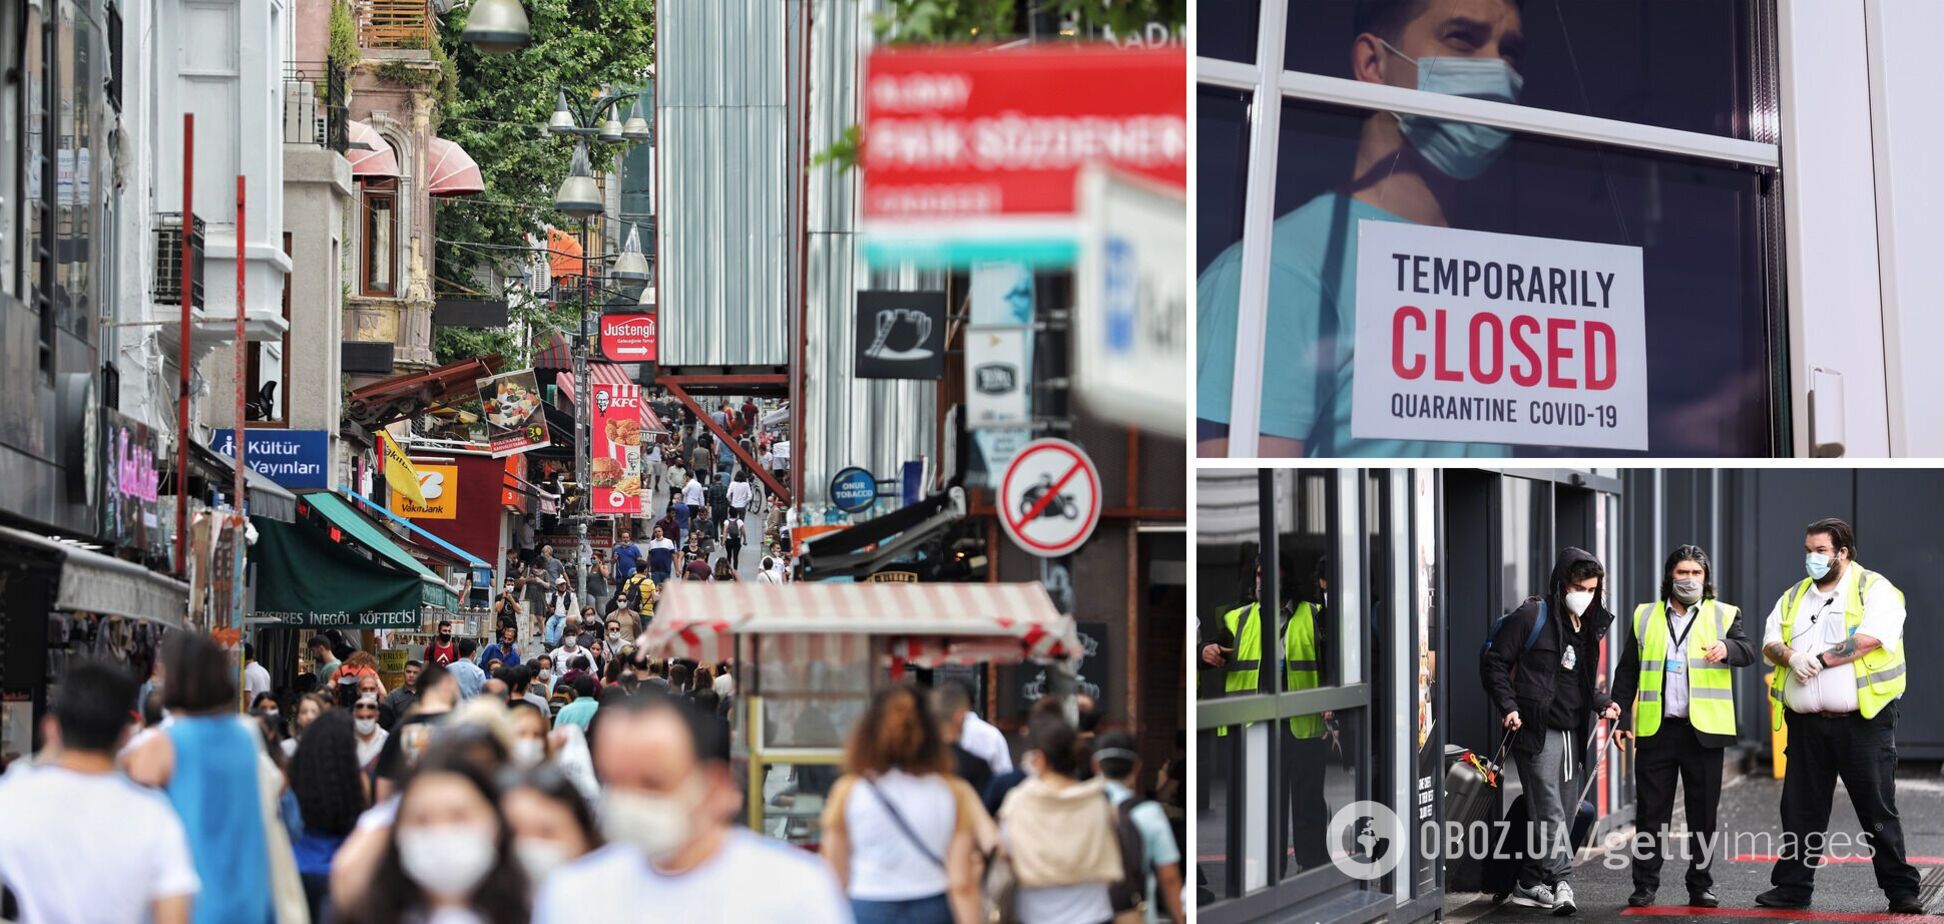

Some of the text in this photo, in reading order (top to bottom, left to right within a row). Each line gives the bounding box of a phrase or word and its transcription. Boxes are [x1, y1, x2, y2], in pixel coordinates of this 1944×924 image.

[1392, 253, 1615, 308] TEMPORARILY
[1392, 305, 1617, 391] CLOSED
[611, 398, 638, 408] KFC
[1391, 393, 1617, 428] QUARANTINE COVID-19
[248, 440, 301, 455] Kültür
[249, 460, 320, 476] Yayınları
[843, 482, 865, 490] ONUR
[508, 492, 513, 500] 3
[836, 490, 873, 498] TOBACCO
[310, 610, 353, 625] İNEGÖL
[360, 609, 415, 625] KÖFTECİSİ
